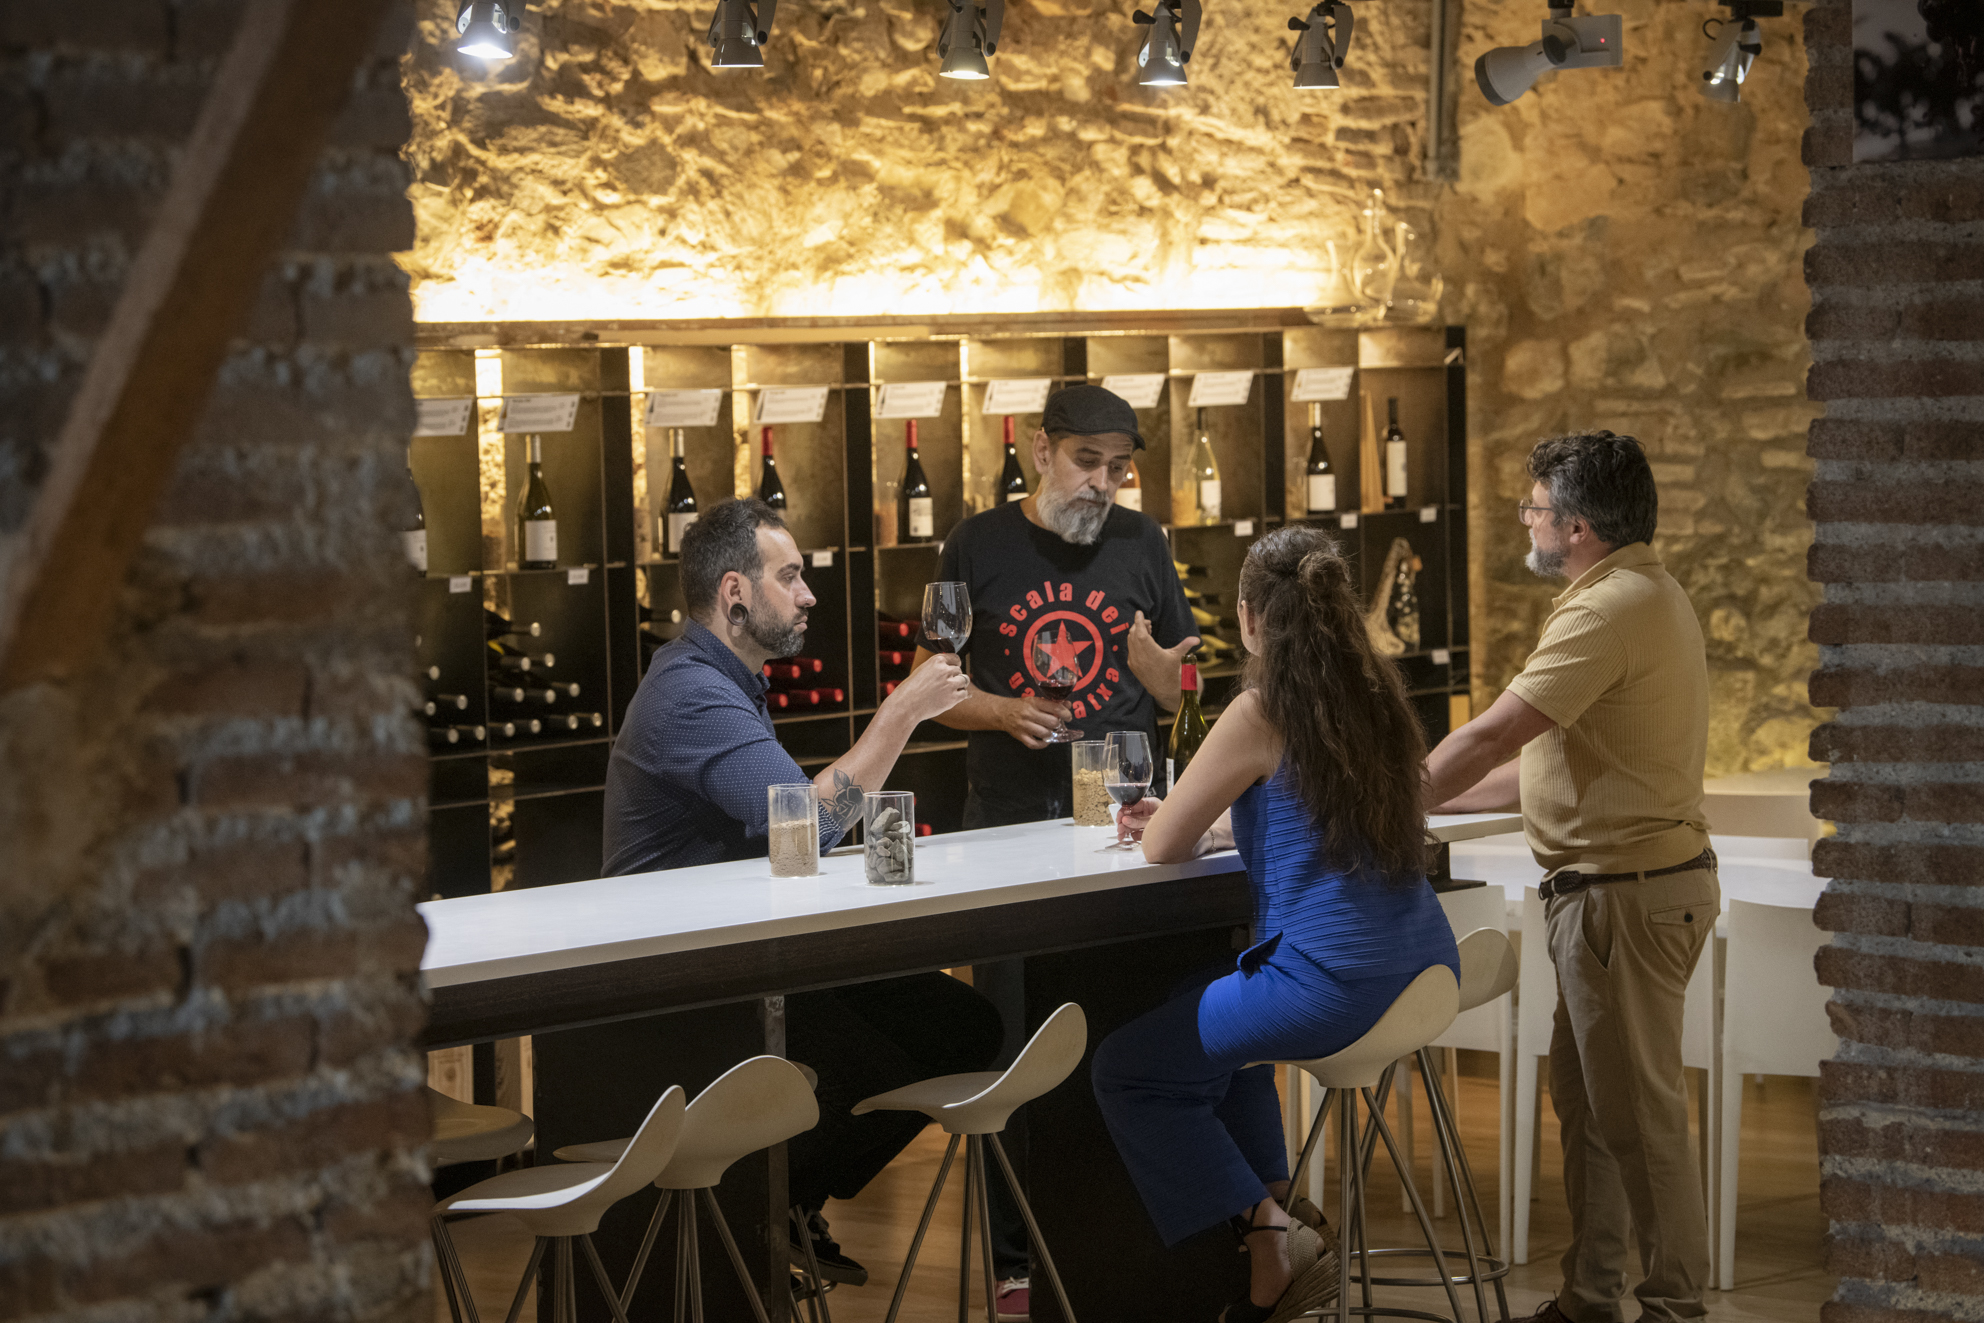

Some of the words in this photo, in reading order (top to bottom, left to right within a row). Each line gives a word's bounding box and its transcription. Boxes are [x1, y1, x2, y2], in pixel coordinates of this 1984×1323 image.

[999, 580, 1073, 637] scala
[1085, 589, 1130, 635] dei
[1008, 667, 1120, 719] gaatxa
